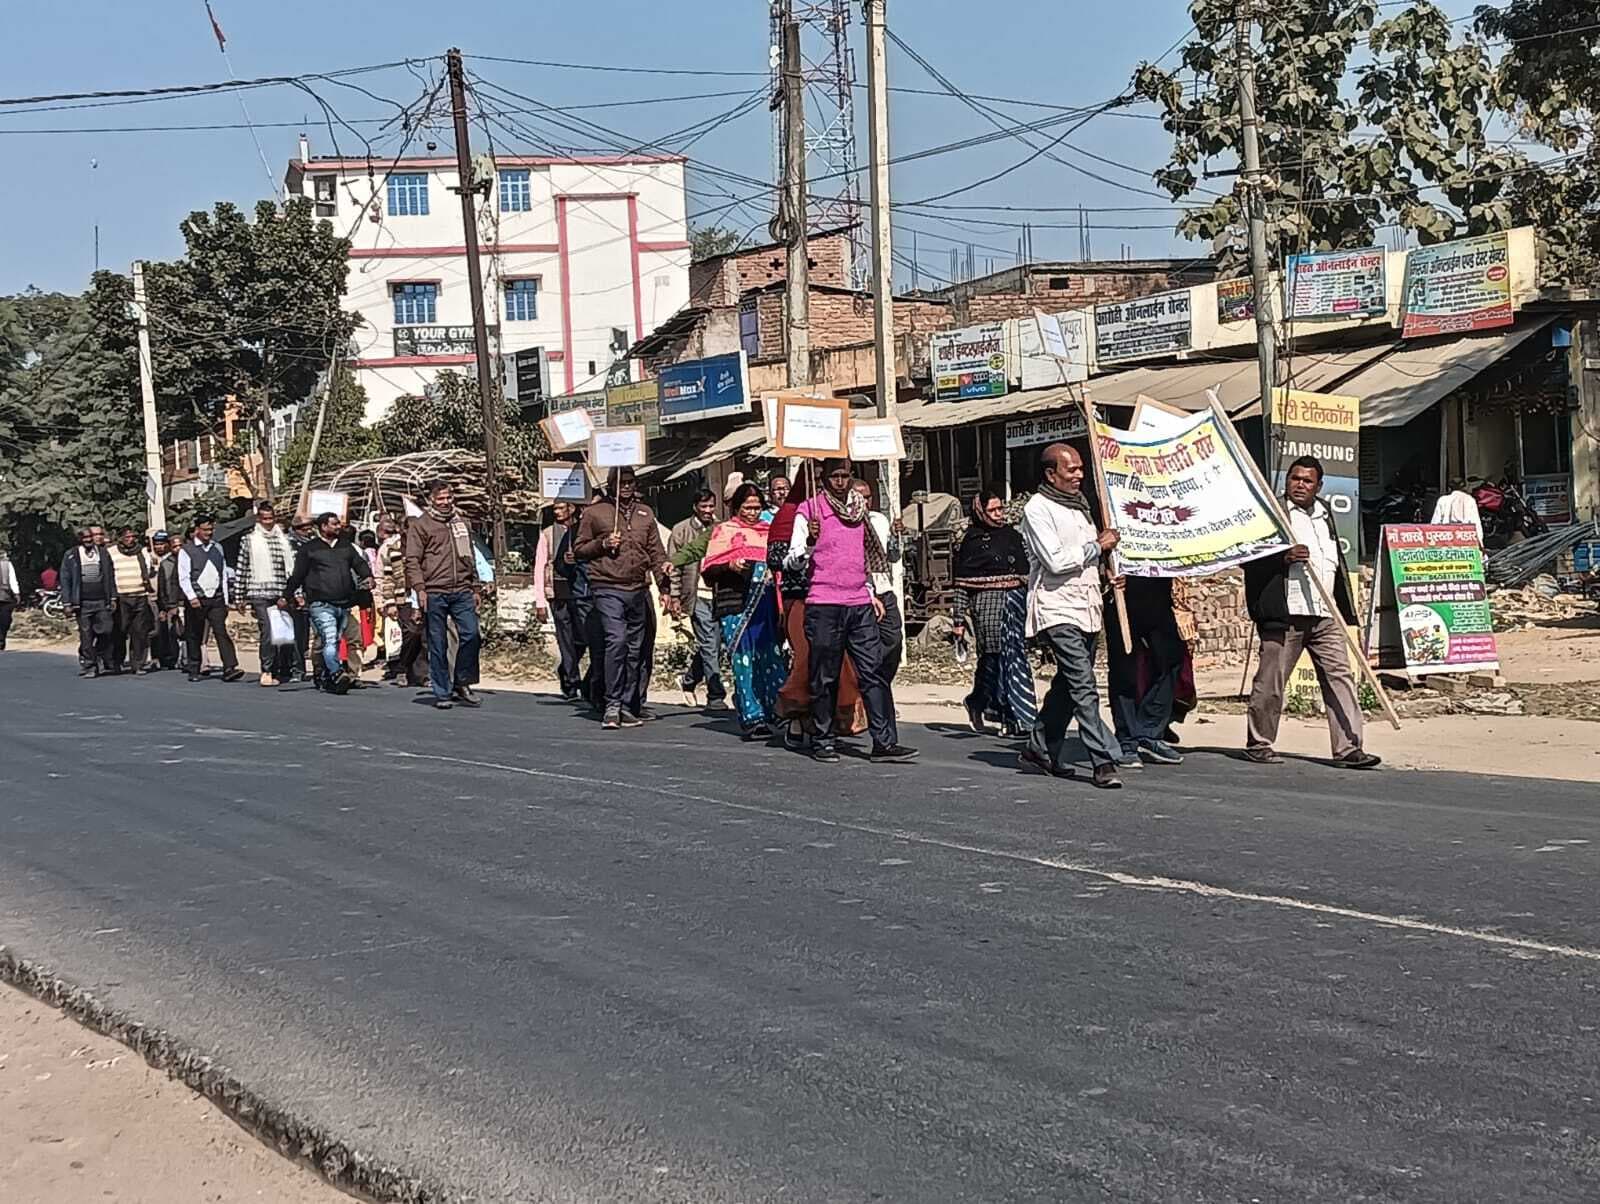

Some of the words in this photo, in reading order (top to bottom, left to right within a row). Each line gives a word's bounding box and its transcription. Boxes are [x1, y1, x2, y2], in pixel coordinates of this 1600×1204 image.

[1097, 304, 1122, 326] आरोही
[1125, 299, 1165, 322] ऑनलाईन
[412, 328, 446, 339] YOUR
[448, 327, 476, 338] GYM
[1301, 400, 1354, 427] टेलिकॉम
[1277, 440, 1355, 462] SAMSUNG
